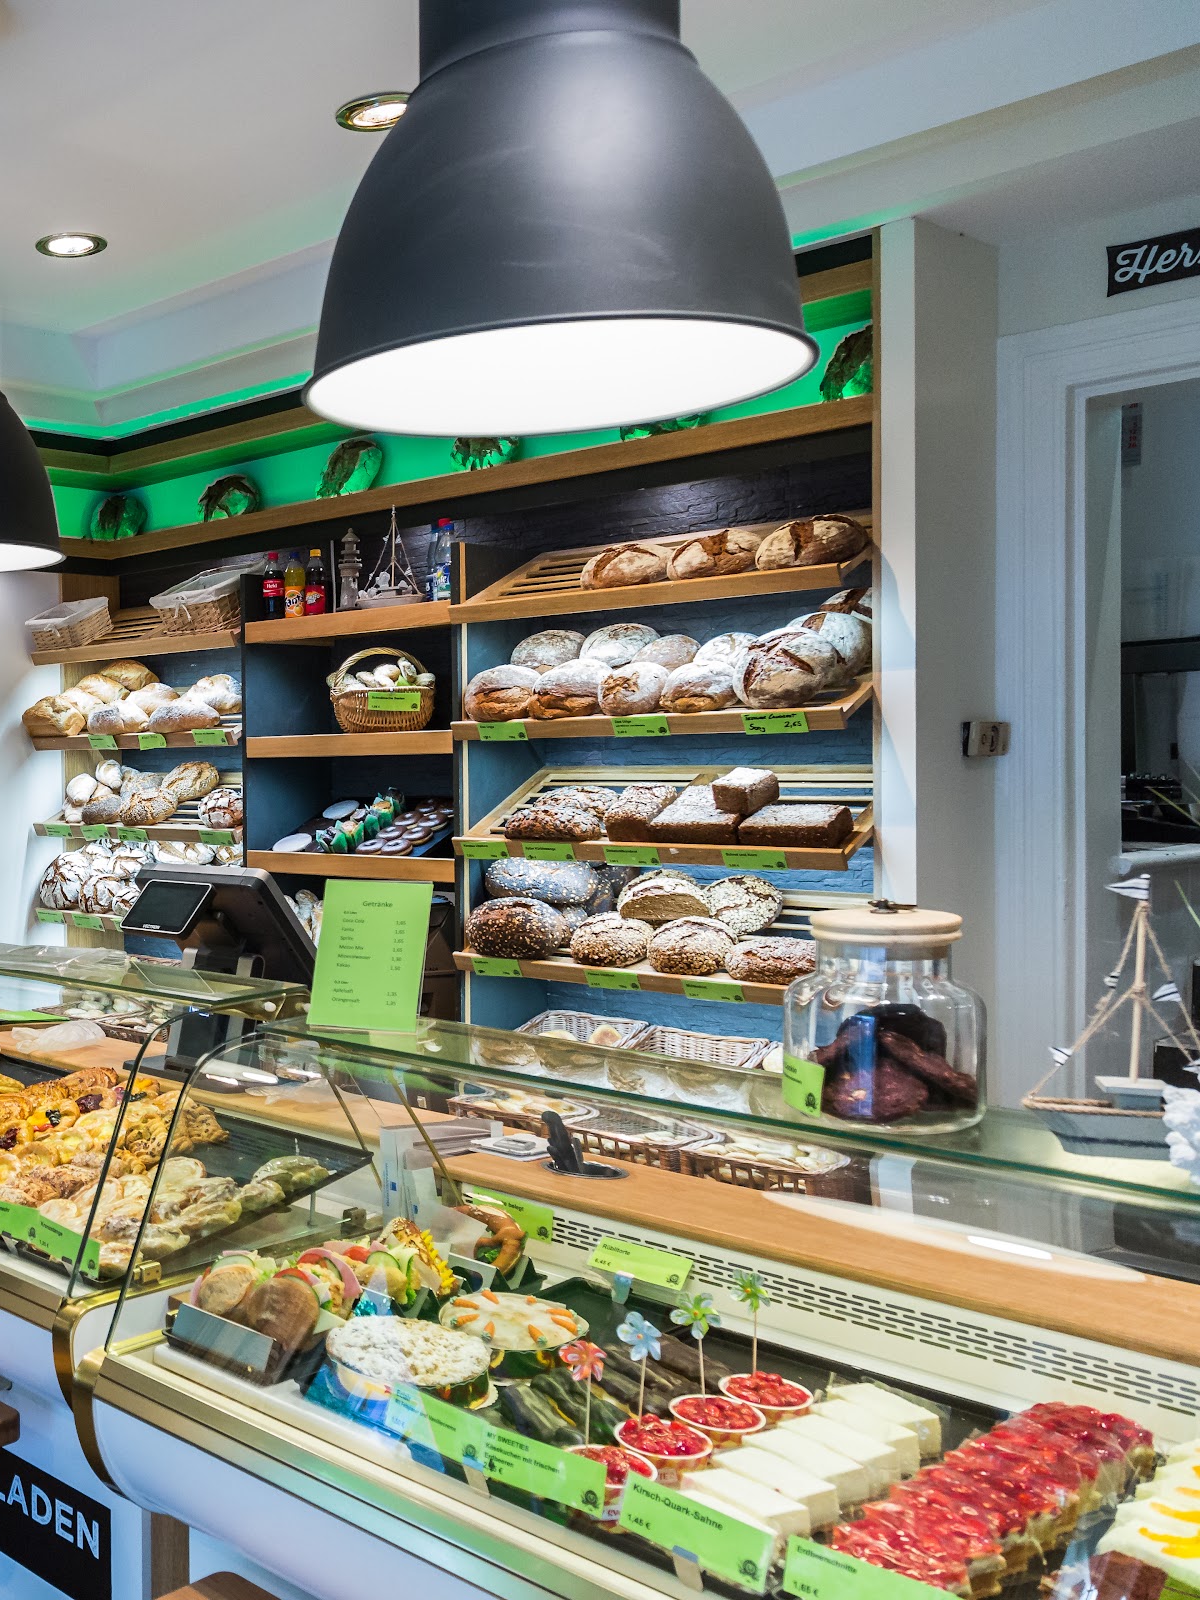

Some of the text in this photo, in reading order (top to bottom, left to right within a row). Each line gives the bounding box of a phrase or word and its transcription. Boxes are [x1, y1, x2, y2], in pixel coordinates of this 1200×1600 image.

[362, 900, 393, 909] Getränke
[497, 1435, 530, 1452] SWEETIES
[632, 1482, 724, 1533] Kirsch-Quark-Sahne
